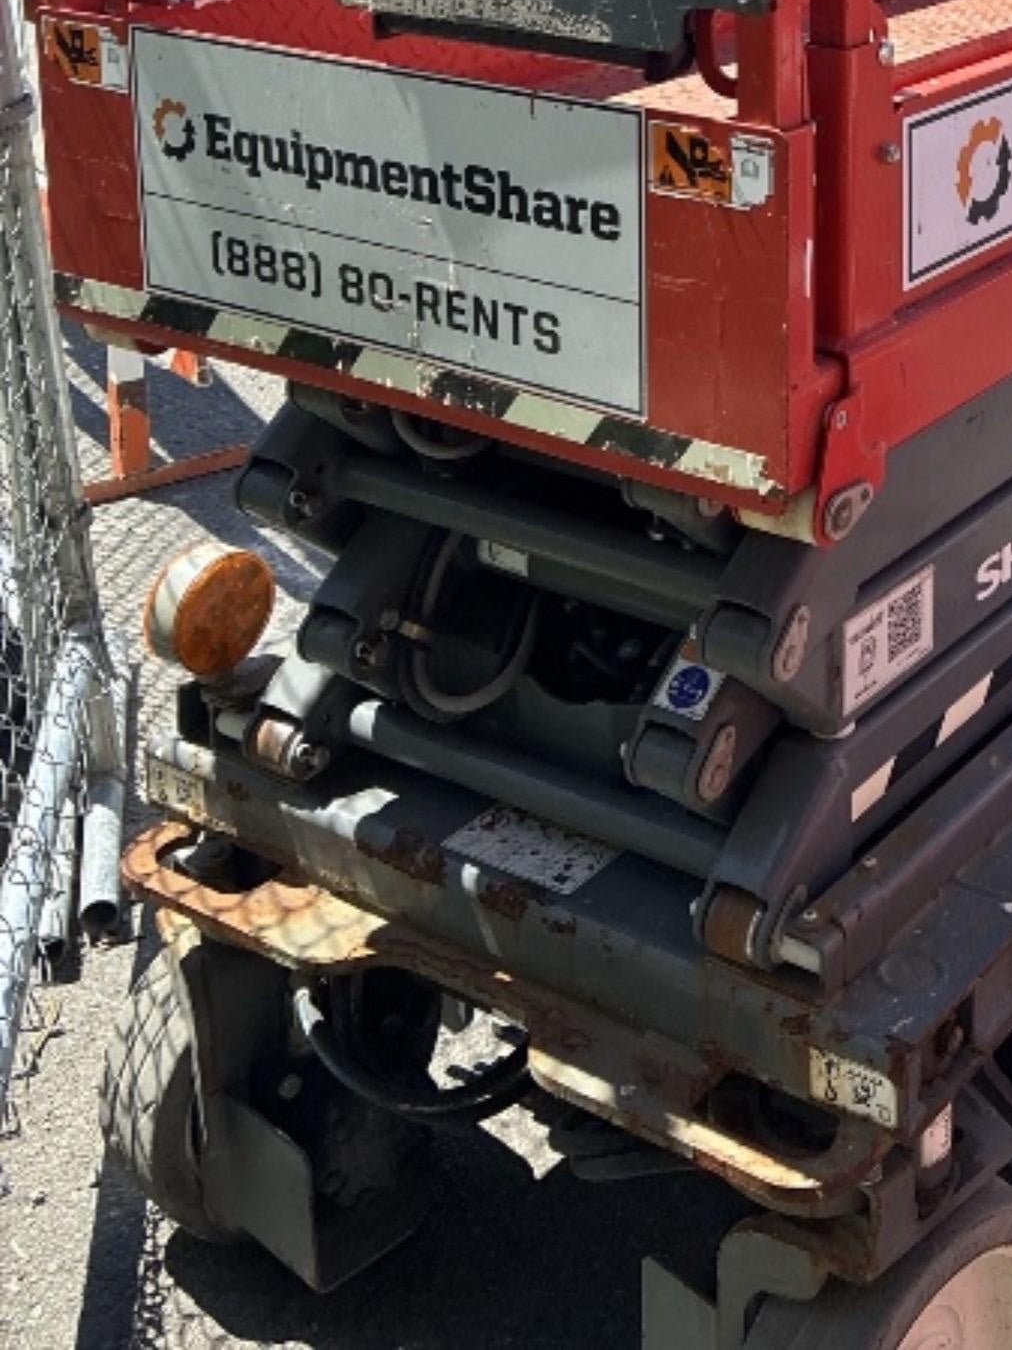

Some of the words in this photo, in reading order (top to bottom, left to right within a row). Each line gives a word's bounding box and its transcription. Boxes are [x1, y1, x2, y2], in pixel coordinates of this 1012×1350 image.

[202, 112, 623, 243] EquipmentShare
[210, 228, 323, 298] (888)
[338, 263, 563, 356] 80-RENTS
